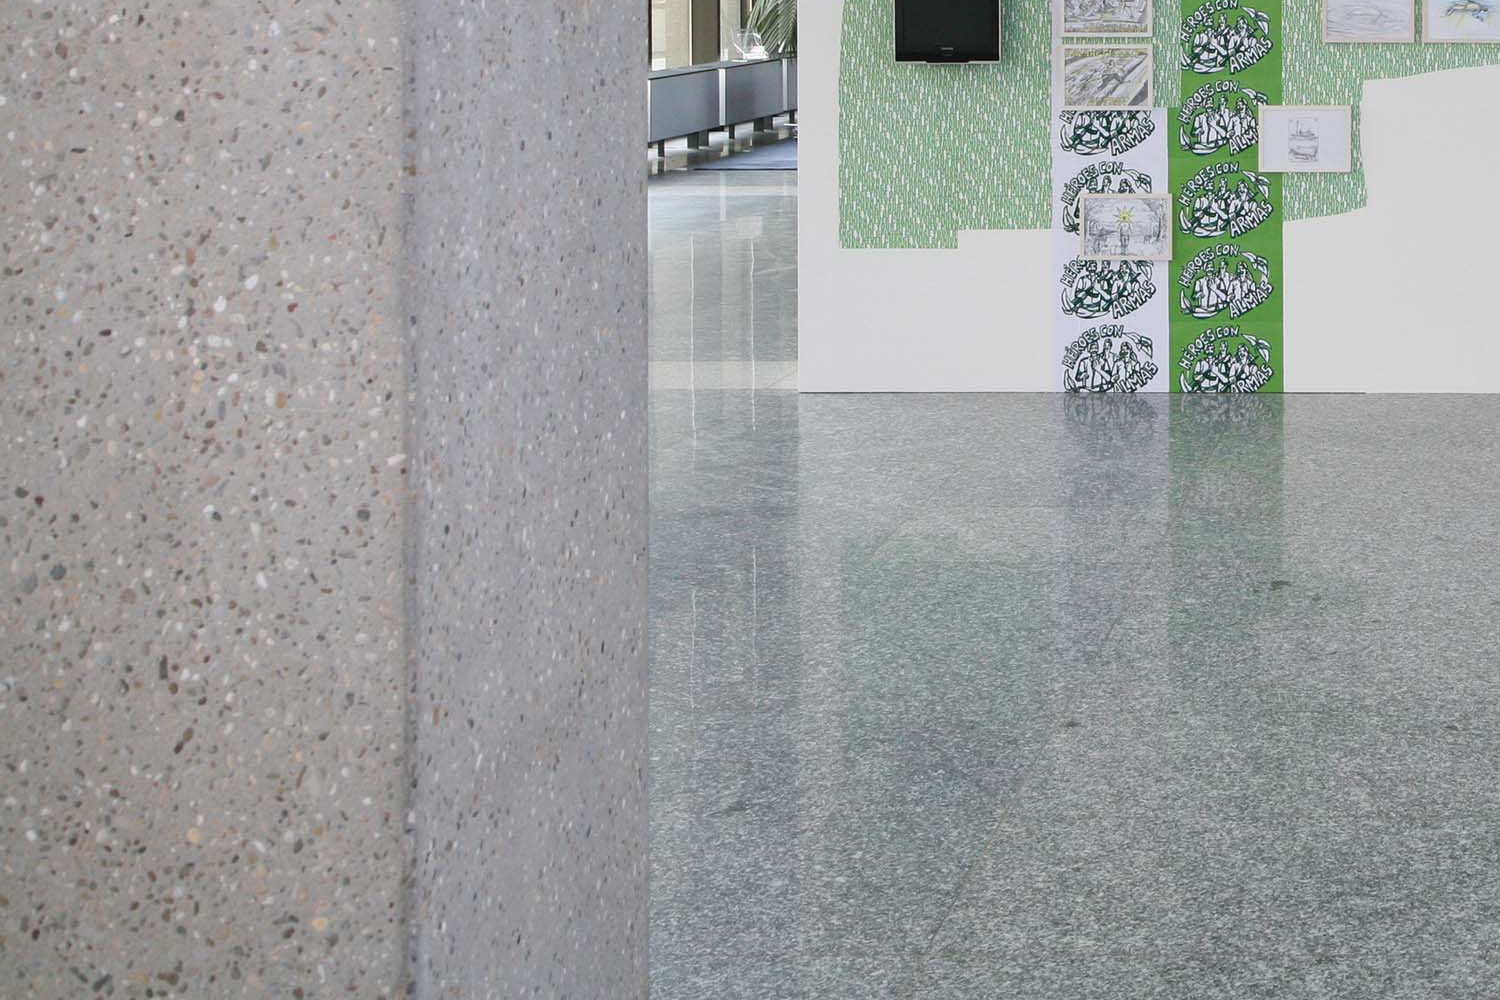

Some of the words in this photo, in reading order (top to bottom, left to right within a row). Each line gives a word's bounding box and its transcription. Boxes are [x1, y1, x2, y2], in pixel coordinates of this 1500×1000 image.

[1228, 36, 1274, 74] ARMAS
[1215, 80, 1240, 93] CON
[1110, 117, 1155, 157] ARMAS
[1228, 129, 1258, 156] ALM
[1099, 161, 1123, 175] CON
[1215, 161, 1240, 174] CON
[1229, 201, 1274, 239] ARMAS
[1215, 243, 1240, 256] CON
[1112, 279, 1156, 319] ARMAS
[1229, 282, 1274, 320] ALMAS
[1099, 324, 1124, 338] CON
[1216, 325, 1240, 338] CON
